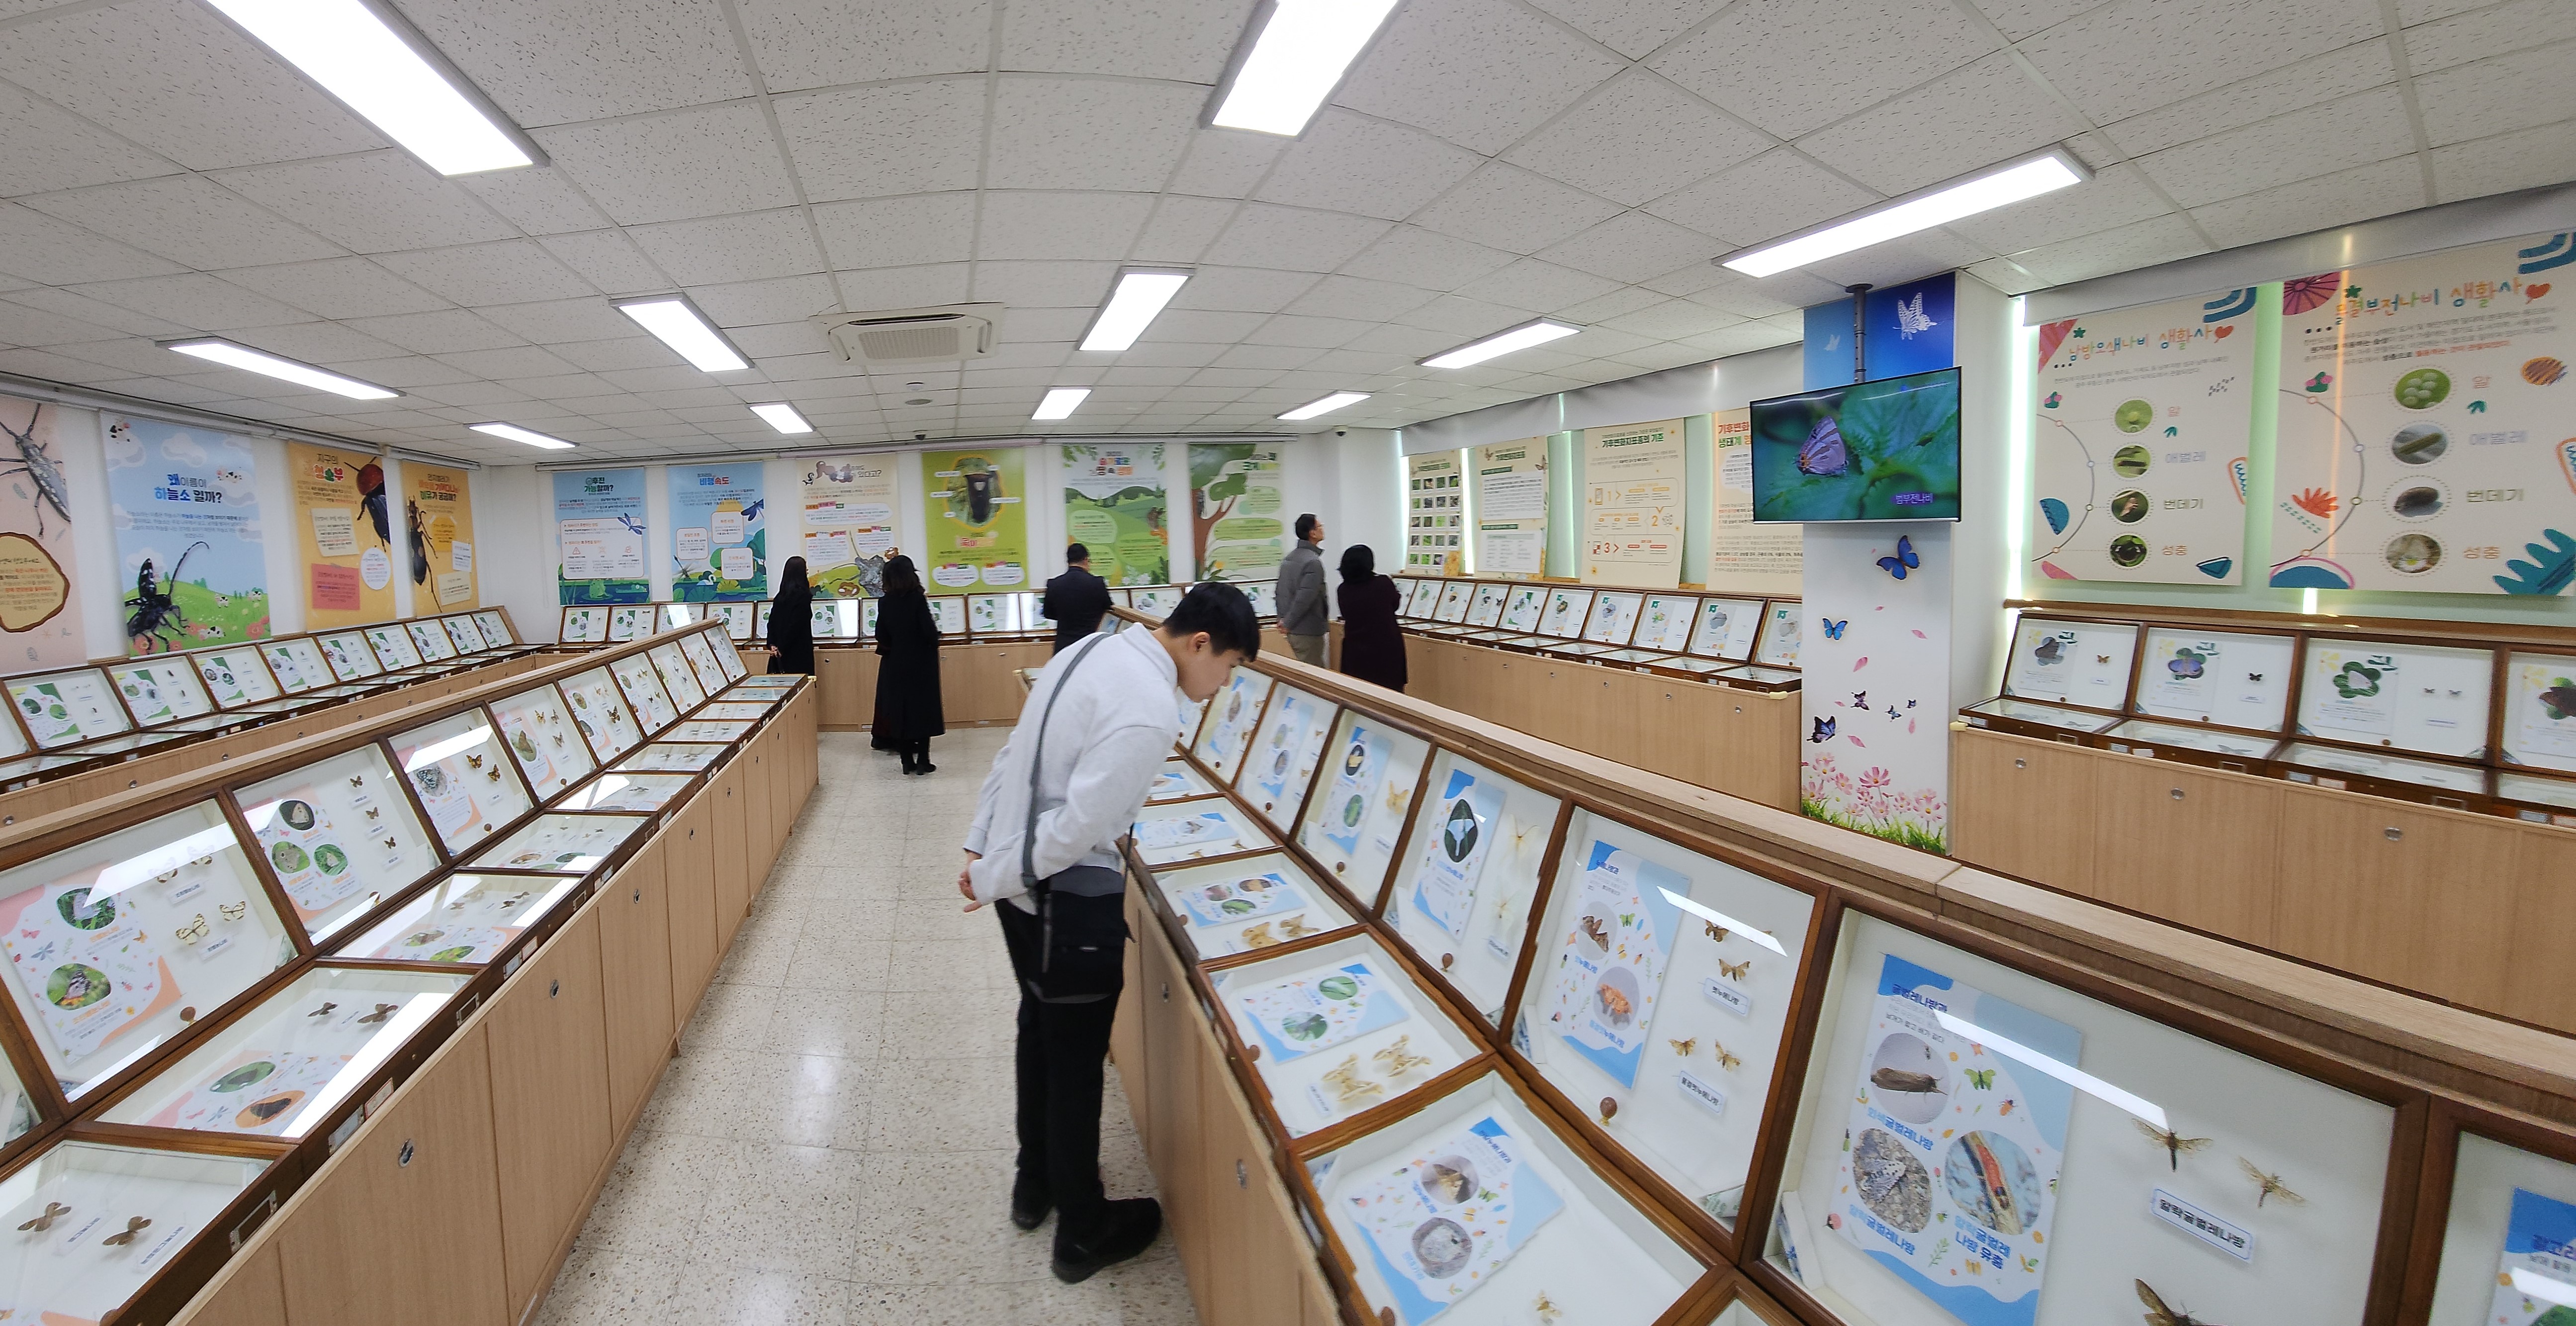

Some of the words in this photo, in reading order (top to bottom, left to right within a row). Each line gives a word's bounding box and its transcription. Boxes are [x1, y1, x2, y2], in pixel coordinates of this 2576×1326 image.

[2451, 277, 2523, 308] 생활사
[2069, 334, 2149, 361] 남방오색나비
[2159, 324, 2213, 350] 생활사
[2472, 376, 2492, 389] 알
[2168, 406, 2181, 417] 알
[1718, 421, 1750, 434] 기후변화
[1602, 435, 1650, 448] 기후변화지표종의
[1651, 433, 1664, 442] 기준
[2469, 430, 2530, 446] 애벌레
[317, 453, 339, 464] 지구의
[2165, 451, 2207, 464] 애벌레
[700, 476, 729, 485] 비행속도
[154, 486, 191, 501] 하늘소
[193, 489, 223, 503] 일까?
[420, 490, 438, 500] 이유가
[438, 491, 456, 502] 궁금해?
[1607, 490, 1611, 501] 1
[1895, 493, 1934, 504] 범부전나비
[2466, 488, 2524, 503] 번데기
[2163, 498, 2204, 510] 번데기
[1652, 515, 1658, 527] 2
[1604, 542, 1610, 553] 3
[2162, 545, 2188, 556] 성충
[2463, 547, 2500, 560] 성충
[1892, 983, 1948, 1013] 굴벌레나방과
[1868, 1106, 1934, 1151] 회색굴벌레나방
[1849, 1203, 1915, 1256] 알락굴벌레나방
[2160, 1198, 2246, 1249] 알락굴벌레나방
[1954, 1215, 2012, 1259] 알락굴벌레
[1955, 1231, 1979, 1254] 나방
[1980, 1246, 2004, 1270] 유충
